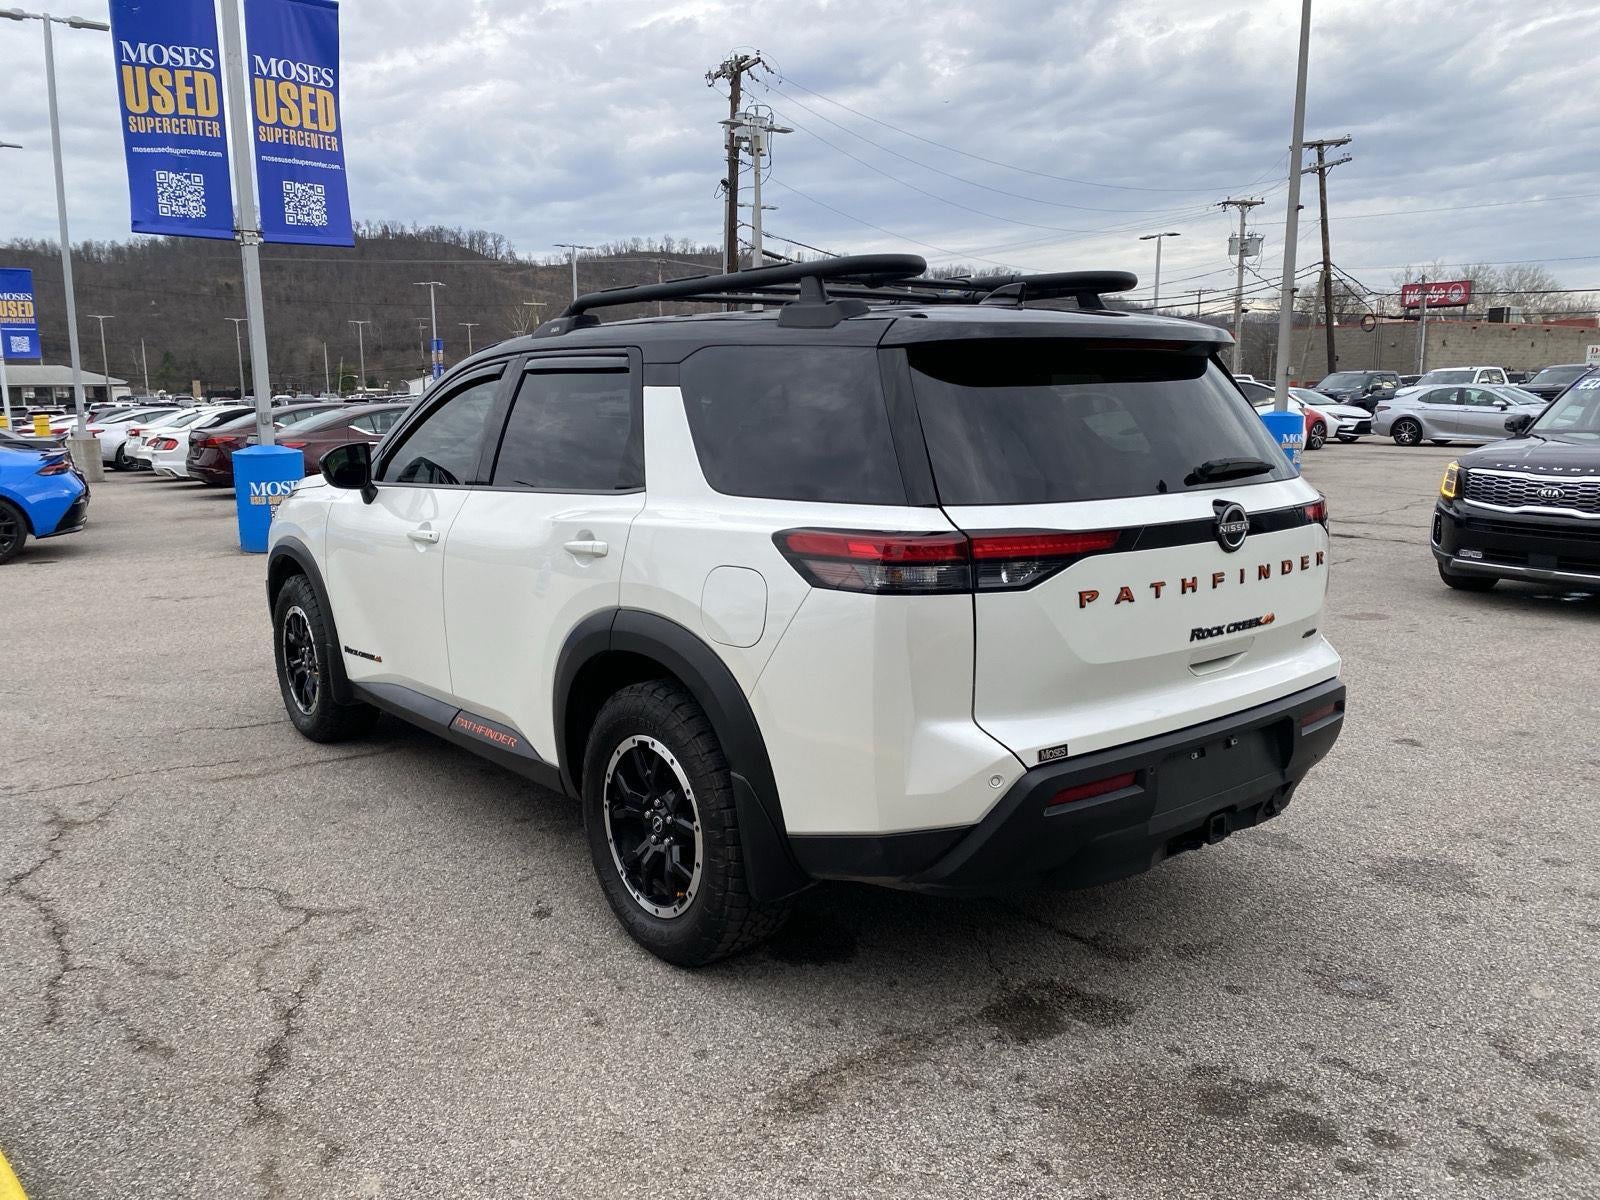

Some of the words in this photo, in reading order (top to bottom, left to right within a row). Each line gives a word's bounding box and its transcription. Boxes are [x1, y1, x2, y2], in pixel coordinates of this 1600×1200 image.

[119, 40, 215, 70] MOSES
[253, 54, 334, 88] MOSES
[121, 65, 219, 118] USED
[254, 77, 337, 133] USED
[128, 116, 221, 138] SUPERCENTER
[258, 125, 339, 152] SUPERCENTER
[132, 146, 223, 158] mosesusedsupercenter.com
[0, 301, 34, 317] USED
[1220, 522, 1249, 532] NISSAN
[1078, 551, 1325, 609] PATHFINDER
[1189, 624, 1226, 642] ROCK
[1226, 616, 1264, 634] CREEK
[455, 717, 518, 748] PATHFINDER
[1041, 747, 1066, 760] MOSES
